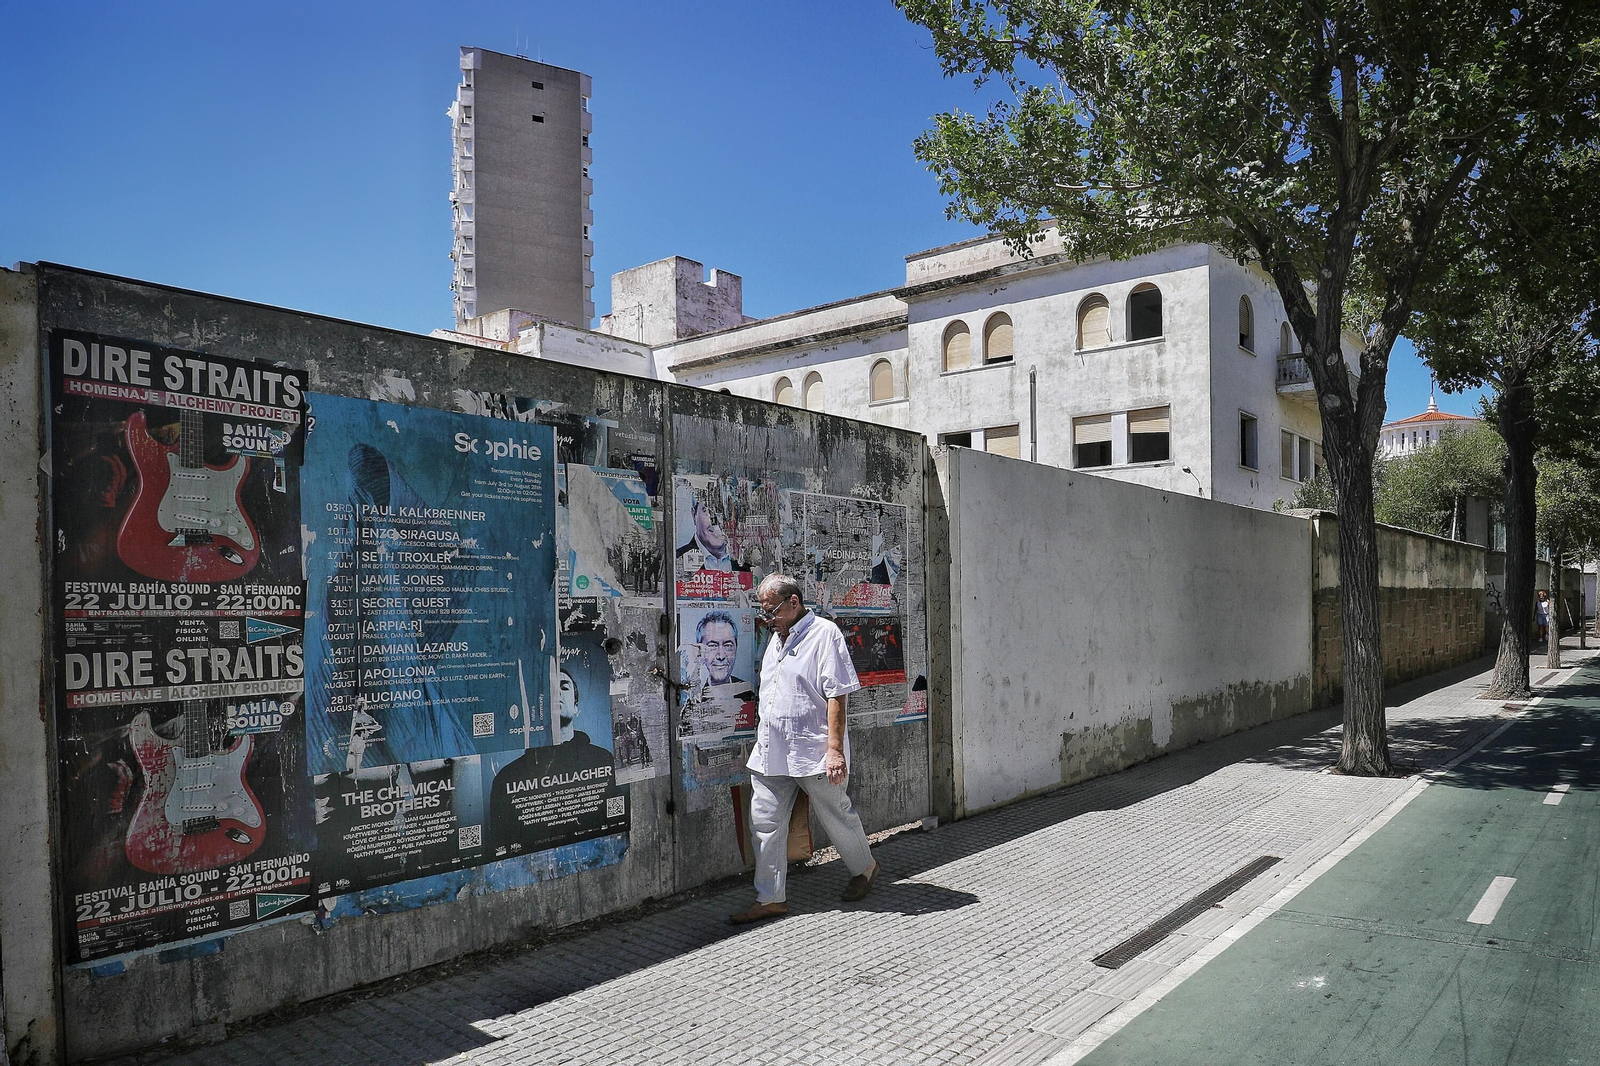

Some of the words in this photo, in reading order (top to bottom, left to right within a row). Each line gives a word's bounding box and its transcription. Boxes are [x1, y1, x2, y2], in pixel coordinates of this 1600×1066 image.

[63, 338, 151, 386] DIRE
[164, 356, 300, 407] STRAITS
[70, 380, 159, 402] HOMENAJE
[168, 394, 234, 414] ALCHEMY
[240, 404, 299, 422] PROJECT
[222, 436, 268, 451] SOUN
[326, 503, 353, 513] 03RD
[362, 504, 396, 516] PAUL
[399, 506, 486, 521] KALKBRENNER
[327, 528, 353, 536] 10TH
[400, 530, 460, 541] SIRAGUSA
[327, 551, 353, 560] 17TH
[362, 551, 393, 562] SETH
[397, 552, 451, 563] TROXLER
[826, 550, 856, 559] MEDINA
[327, 576, 353, 584] 24TH
[362, 575, 400, 585] JAMIE
[404, 575, 444, 585] JONES
[65, 582, 126, 593] FESTIVAL
[130, 581, 167, 594] BAHÍA
[171, 584, 210, 594] SOUND
[220, 584, 242, 594] SAN
[245, 585, 301, 595] FERNANDO
[65, 594, 100, 610] 22
[109, 594, 193, 610] JULIO
[216, 595, 300, 610] 22:00h.
[331, 599, 353, 608] 31ST
[362, 598, 408, 608] SECRET
[412, 598, 451, 608] GUEST
[328, 623, 355, 632] 07TH
[363, 619, 422, 633] [A:RPIA:R]
[330, 648, 355, 656] 14TH
[363, 644, 414, 656] DAMIAN
[416, 642, 468, 653] LAZARUS
[65, 650, 154, 689] DIRE
[166, 645, 304, 684] STRAITS
[364, 665, 436, 680] APOLLONIA
[332, 670, 355, 680] 21ST
[324, 681, 356, 689] AUGUST
[73, 689, 162, 704] HOMENAJE
[171, 682, 238, 700] ALCHEMY
[244, 680, 302, 694] PROJECT
[364, 689, 421, 703] LUCIANO
[331, 695, 356, 705] 28TH
[227, 714, 282, 729] SOUND
[506, 778, 538, 794] LIAM
[541, 766, 612, 787] GALLAGHER
[342, 790, 374, 806] THE
[377, 779, 455, 800] CHEMICAL
[360, 795, 440, 819] BROTHERS
[350, 824, 370, 832] ARCTIC
[419, 811, 451, 821] GALLAGHER
[343, 830, 379, 840] KRAFTWERK
[378, 832, 400, 841] LESBIAN
[367, 841, 391, 849] MURPHY
[375, 846, 397, 855] PELUSO
[416, 837, 447, 847] FANDANGO
[75, 885, 135, 905] FESTIVAL
[139, 876, 176, 893] BAHÍA
[180, 869, 219, 886] SOUND
[229, 864, 251, 876] SAN
[255, 853, 310, 872] FERNANDO
[76, 901, 110, 922] 22
[120, 884, 202, 912] JULIO
[226, 865, 310, 892] 22:00h.
[189, 905, 215, 915] VENTA
[186, 914, 212, 924] FÍSICA
[187, 921, 219, 932] ONLINE:
